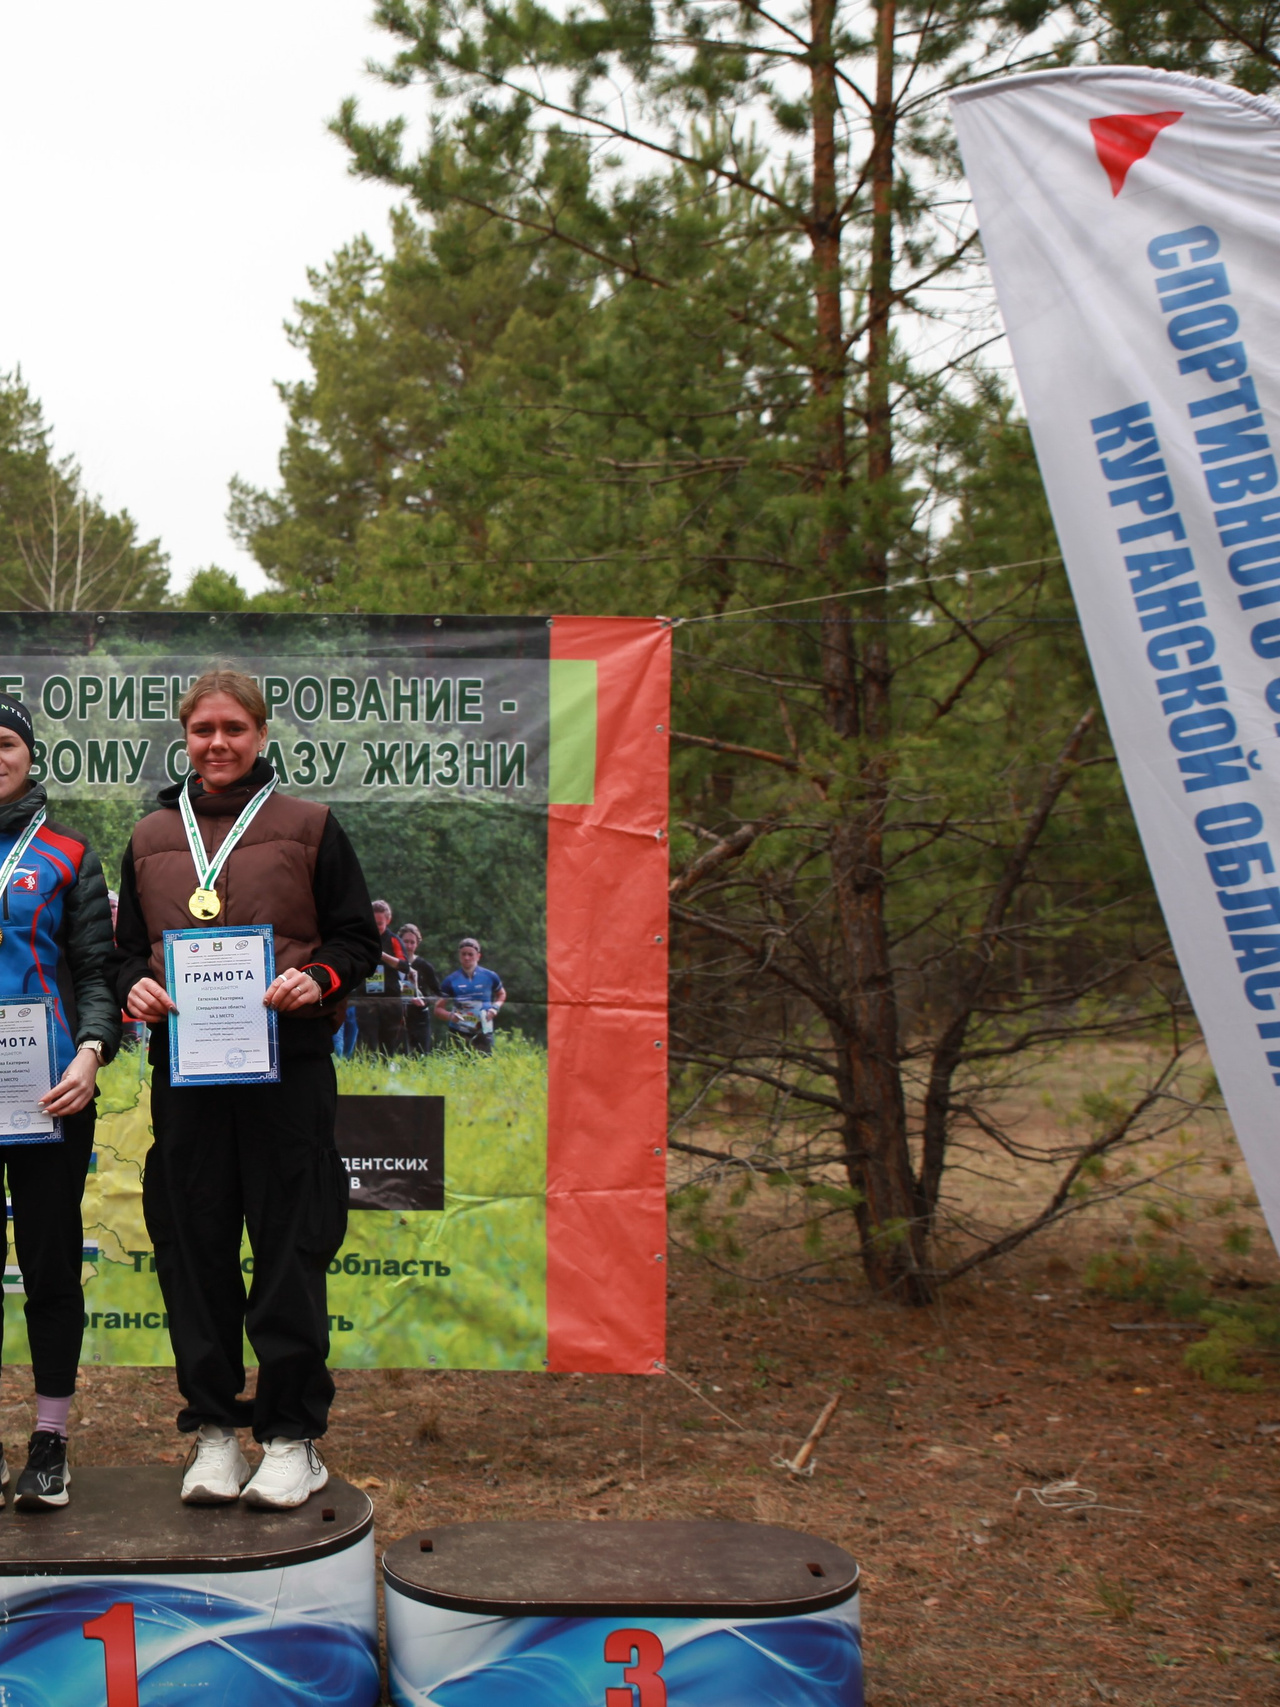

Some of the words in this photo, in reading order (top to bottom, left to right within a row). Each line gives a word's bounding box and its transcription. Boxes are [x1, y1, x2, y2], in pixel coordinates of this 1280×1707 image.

[1147, 225, 1280, 660] СПОРТИВНО
[41, 674, 484, 723] ОРИЕНРОВАНИЕ
[165, 738, 346, 787] ОАЗУ
[362, 740, 527, 789] ЖИЗНИ
[1090, 401, 1263, 793] КУРГАНСКОЙ
[1195, 802, 1280, 1087] ОБЛАС
[184, 970, 254, 983] ГРАМОТА
[341, 1157, 428, 1172] ДЕНТСКИХ
[326, 1253, 451, 1277] область
[81, 1602, 139, 1707] 1
[603, 1628, 667, 1707] 3
